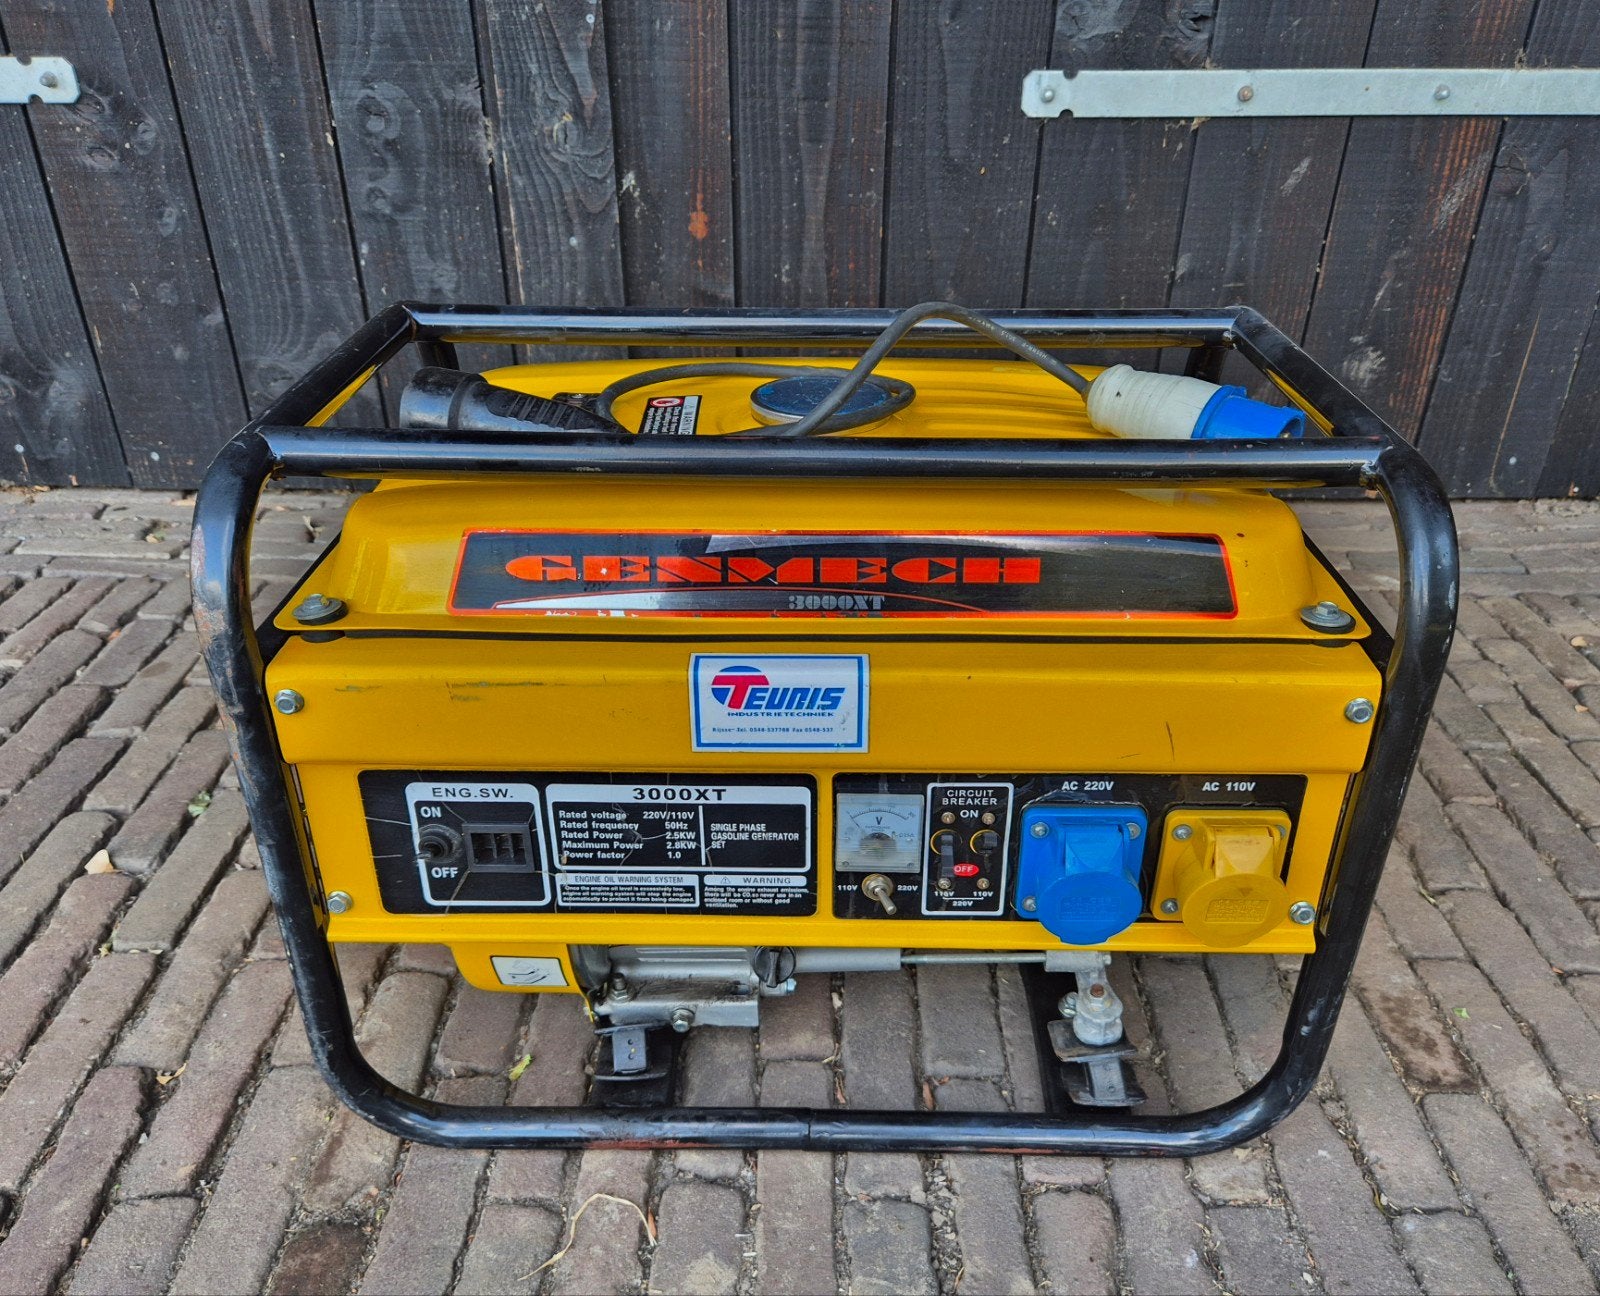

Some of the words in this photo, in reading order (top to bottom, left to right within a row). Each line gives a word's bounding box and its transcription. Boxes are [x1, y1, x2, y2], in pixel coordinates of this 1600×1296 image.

[505, 555, 1041, 583] GENMECH
[788, 594, 885, 611] 3000XT
[1061, 781, 1079, 791] AC
[1083, 781, 1115, 791] 220V
[1202, 782, 1220, 791] AC
[1225, 782, 1256, 791] 110V
[632, 787, 727, 801] 3000XT
[946, 789, 994, 797] CIRCUIT
[942, 797, 998, 806] BREAKER
[420, 806, 442, 818] ON
[558, 810, 587, 819] Rated
[591, 810, 627, 821] voltage
[642, 811, 695, 820] 220V/110V
[960, 810, 979, 818] ON
[560, 820, 588, 829] Rated
[591, 821, 639, 830] frequency
[664, 822, 689, 830] 50Hz
[875, 816, 883, 825] V
[710, 823, 738, 832] SINGLE
[739, 823, 767, 832] PHASE
[561, 831, 589, 839] Rated
[592, 831, 624, 840] Power
[665, 831, 696, 840] 2.5KW
[711, 832, 750, 840] GASOLINE
[751, 832, 800, 840] GENERATOR
[562, 841, 610, 849] Maximum
[613, 841, 644, 850] Power
[666, 842, 697, 850] 2.8KW
[711, 841, 727, 849] SET
[563, 850, 594, 859] Power
[597, 851, 626, 859] factor
[667, 851, 682, 860] 1.0
[431, 867, 458, 878] OFF
[574, 875, 602, 883] ENGINE
[604, 875, 616, 883] OIL
[617, 876, 652, 884] WARNING
[654, 876, 684, 884] SYSTEM
